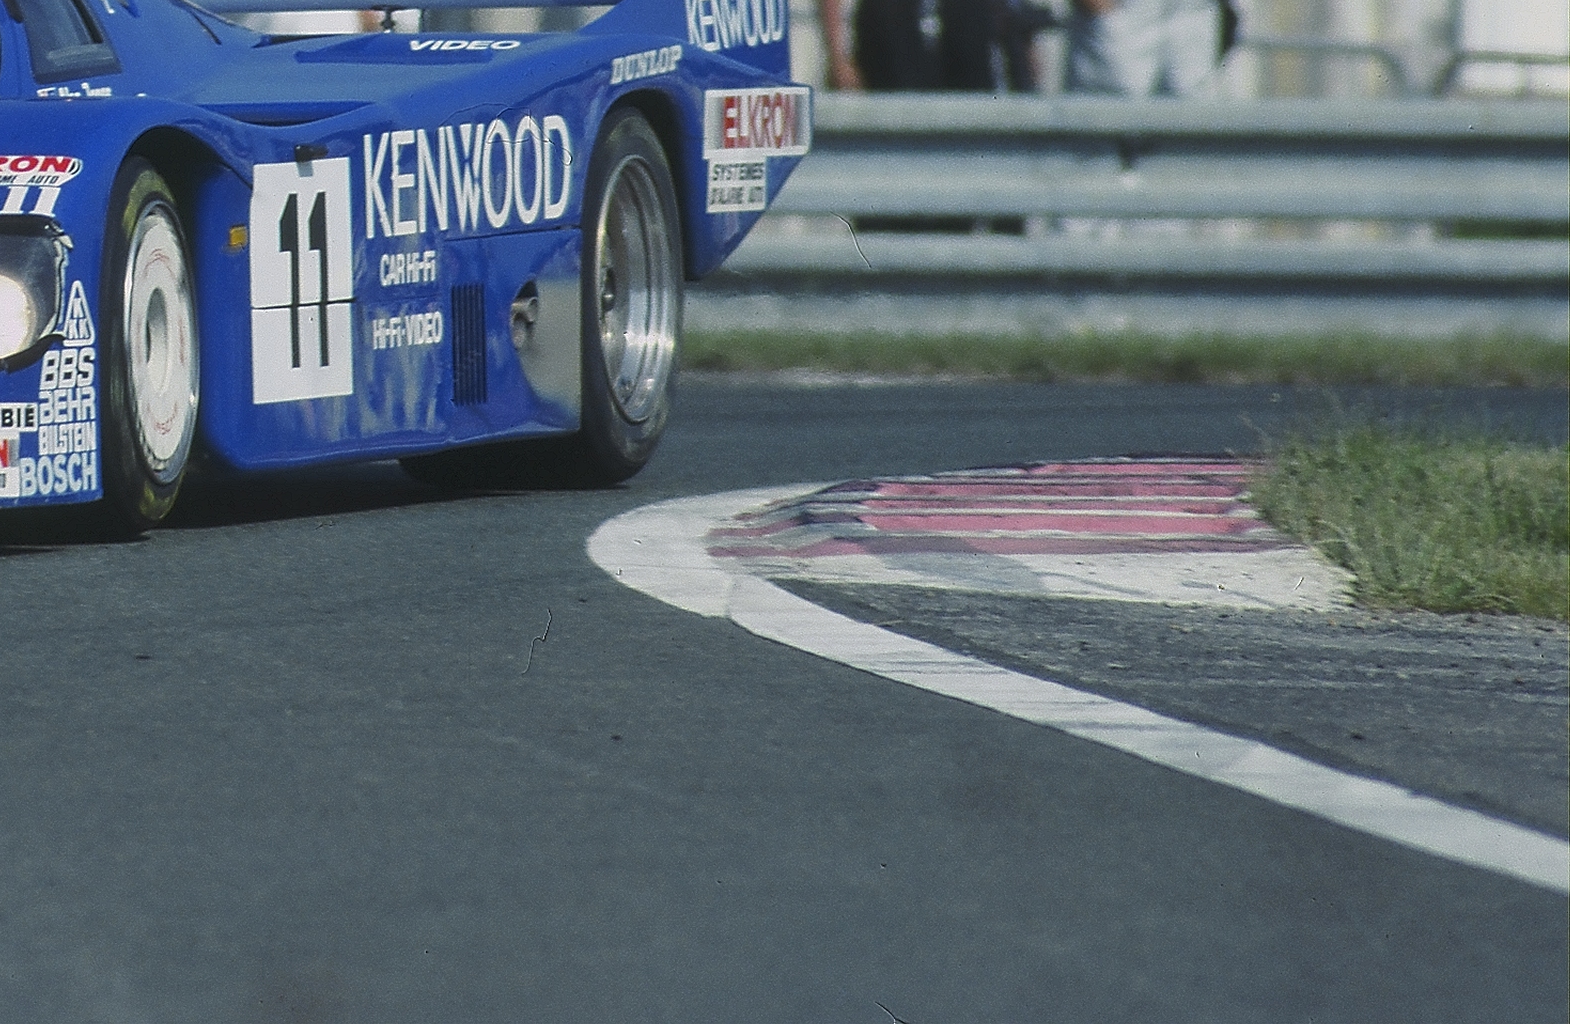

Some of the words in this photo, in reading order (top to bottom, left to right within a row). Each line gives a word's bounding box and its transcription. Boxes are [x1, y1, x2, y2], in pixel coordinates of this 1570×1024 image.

[409, 39, 521, 52] VIDEO
[609, 44, 682, 85] DUNLOP
[722, 92, 798, 149] ELKRON
[362, 114, 574, 239] KENWOOD
[278, 190, 330, 369] 11
[380, 253, 405, 286] CAR
[40, 347, 96, 391] BBS
[38, 387, 97, 425] BEHR
[38, 421, 97, 456] BILSTEIN
[20, 451, 97, 497] BOSCH
